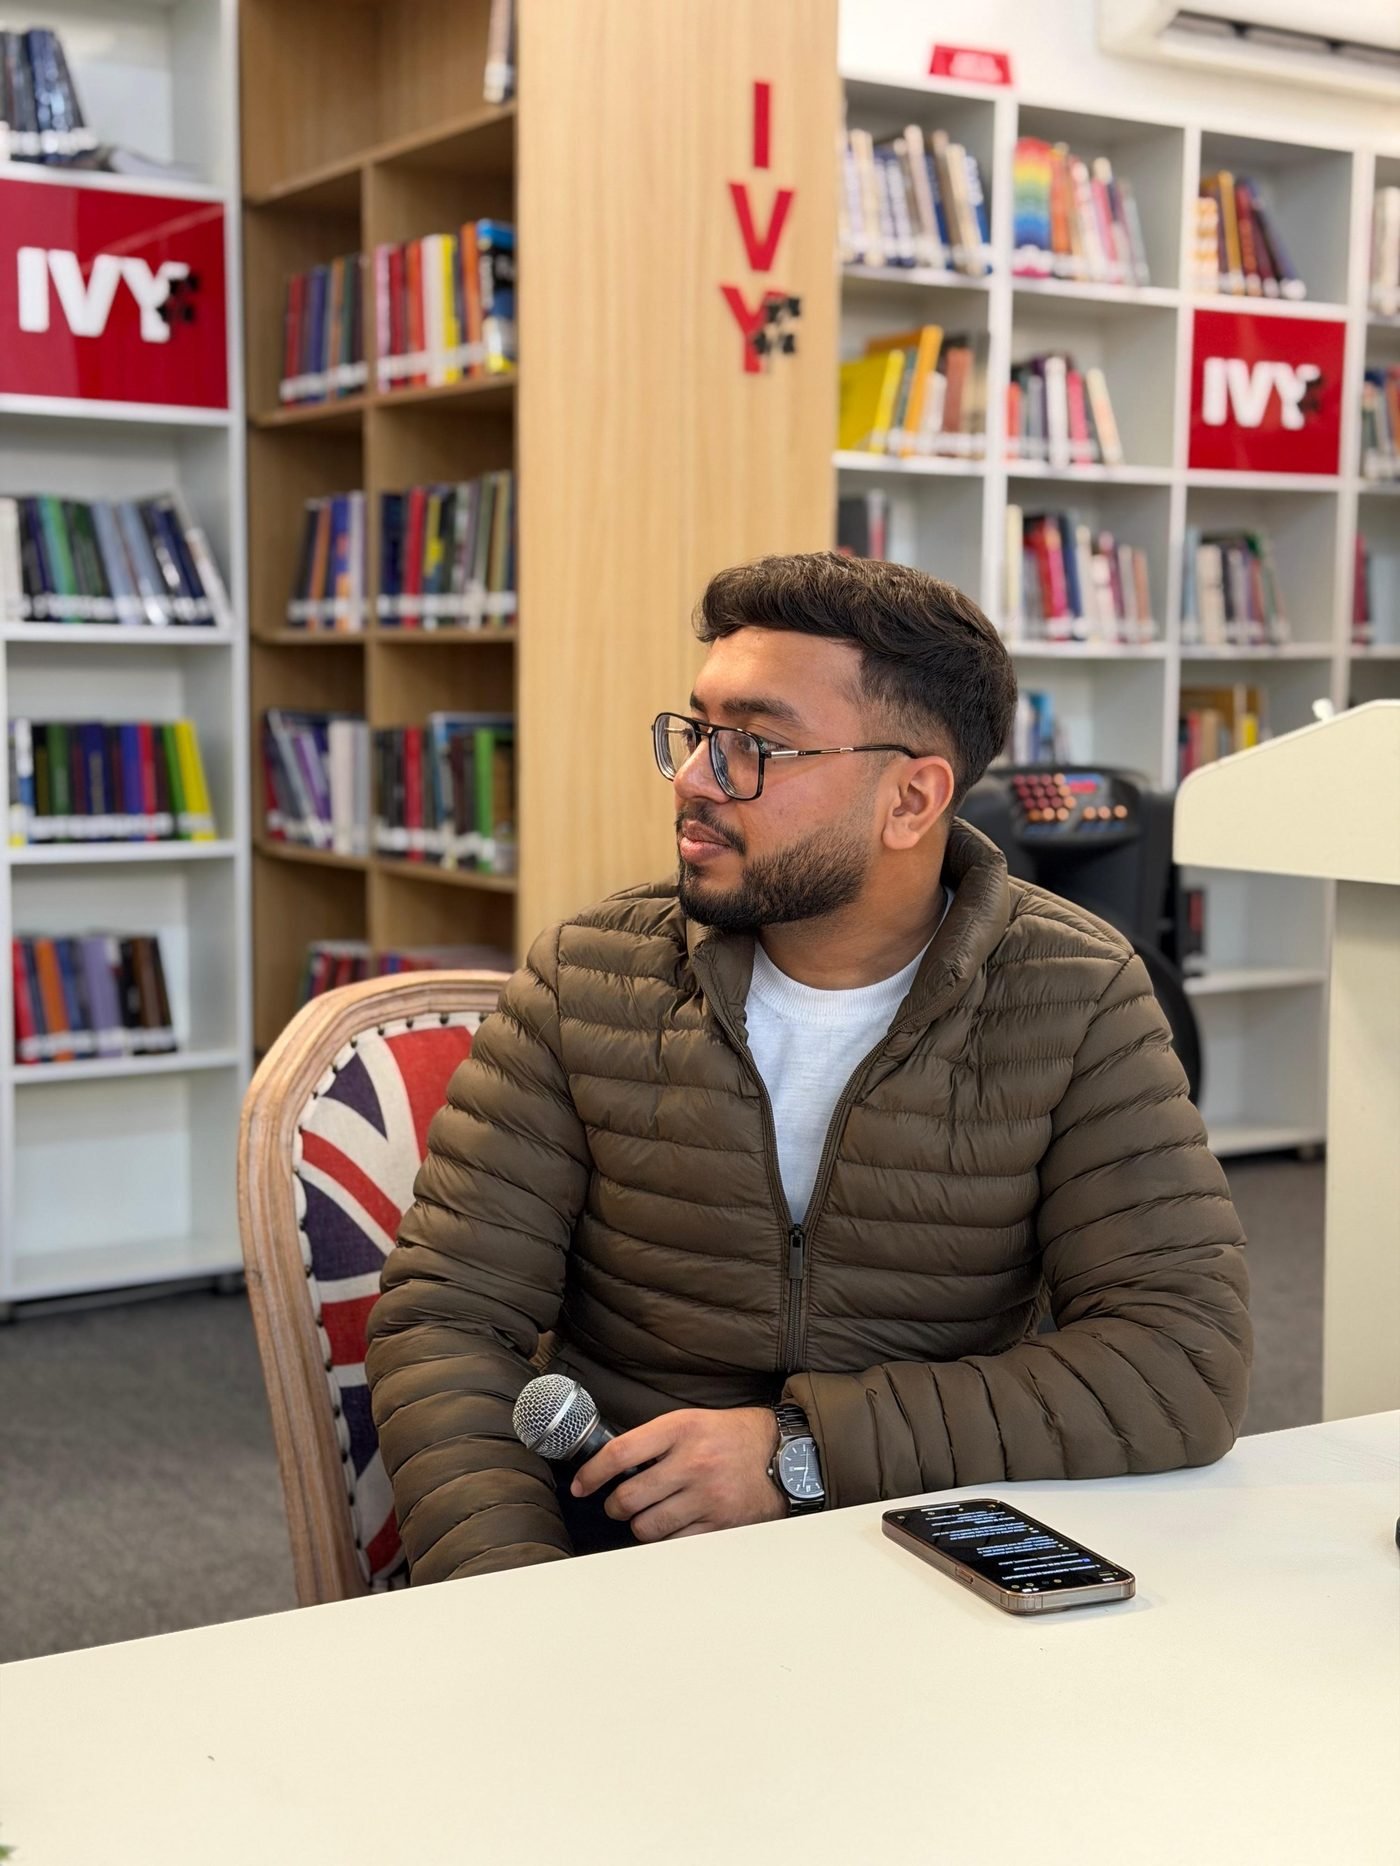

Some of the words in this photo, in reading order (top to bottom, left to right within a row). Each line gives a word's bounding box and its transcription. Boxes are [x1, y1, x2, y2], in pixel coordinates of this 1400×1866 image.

[719, 80, 796, 375] IVY
[17, 246, 190, 343] IVY
[1202, 356, 1321, 431] IVY
